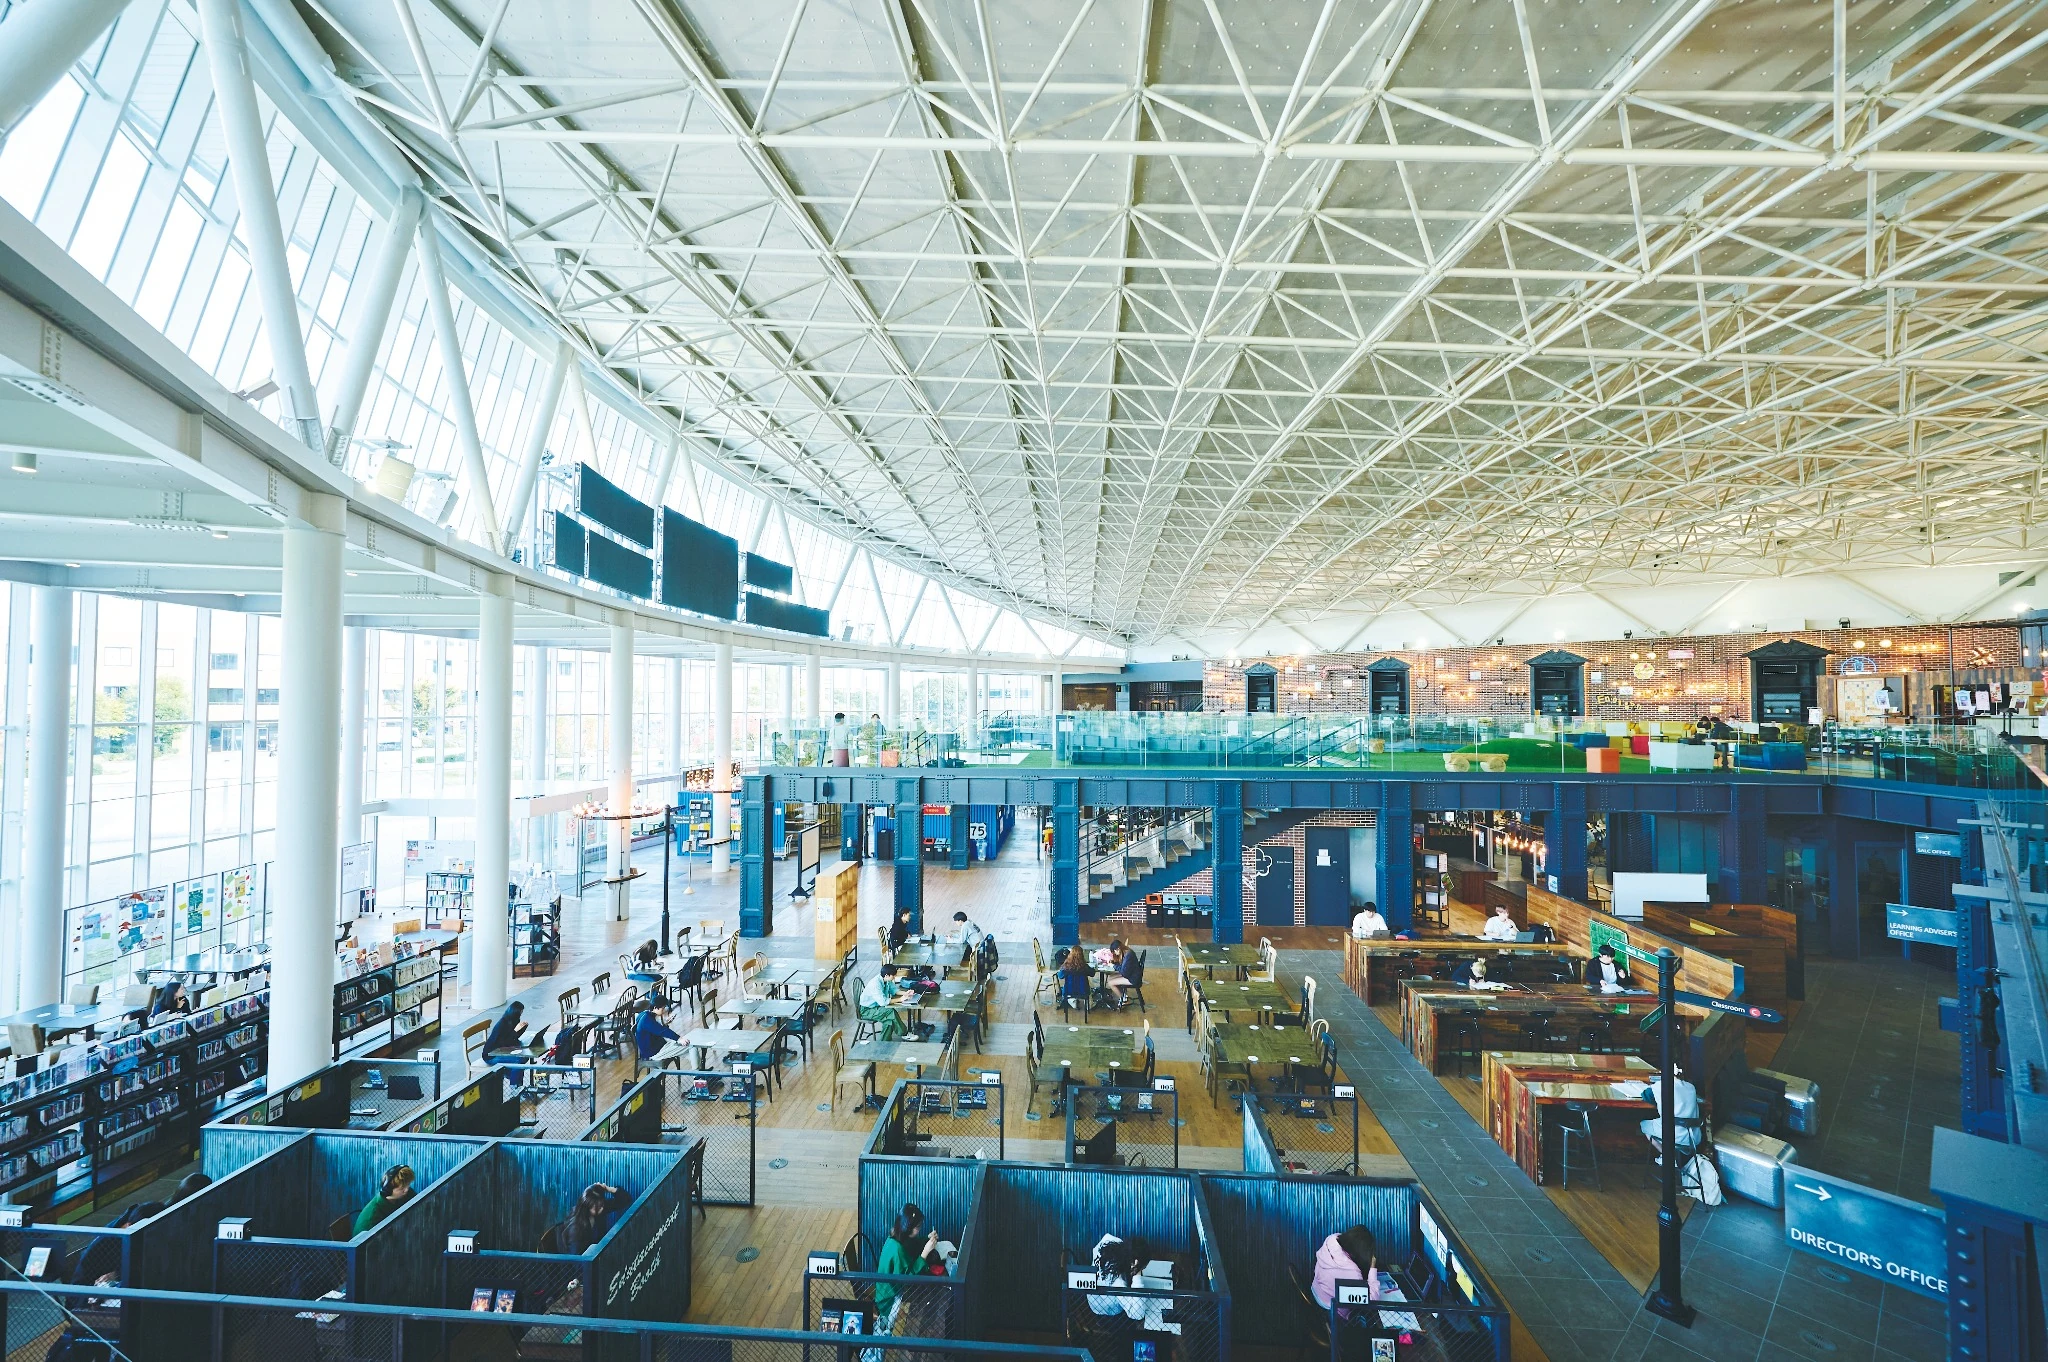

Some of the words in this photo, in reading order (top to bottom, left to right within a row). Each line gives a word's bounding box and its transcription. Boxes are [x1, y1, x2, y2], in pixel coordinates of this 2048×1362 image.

[970, 825, 985, 836] 75
[1889, 922, 1923, 933] LEARNING
[1889, 929, 1914, 939] OFFICE
[1711, 1000, 1746, 1013] Classroom
[6, 1217, 22, 1226] 012
[1790, 1227, 1883, 1271] DIRECTOR'S
[1886, 1261, 1949, 1294] OFFICE
[816, 1265, 835, 1274] 009
[1076, 1279, 1096, 1289] 008
[1348, 1294, 1368, 1304] 007
